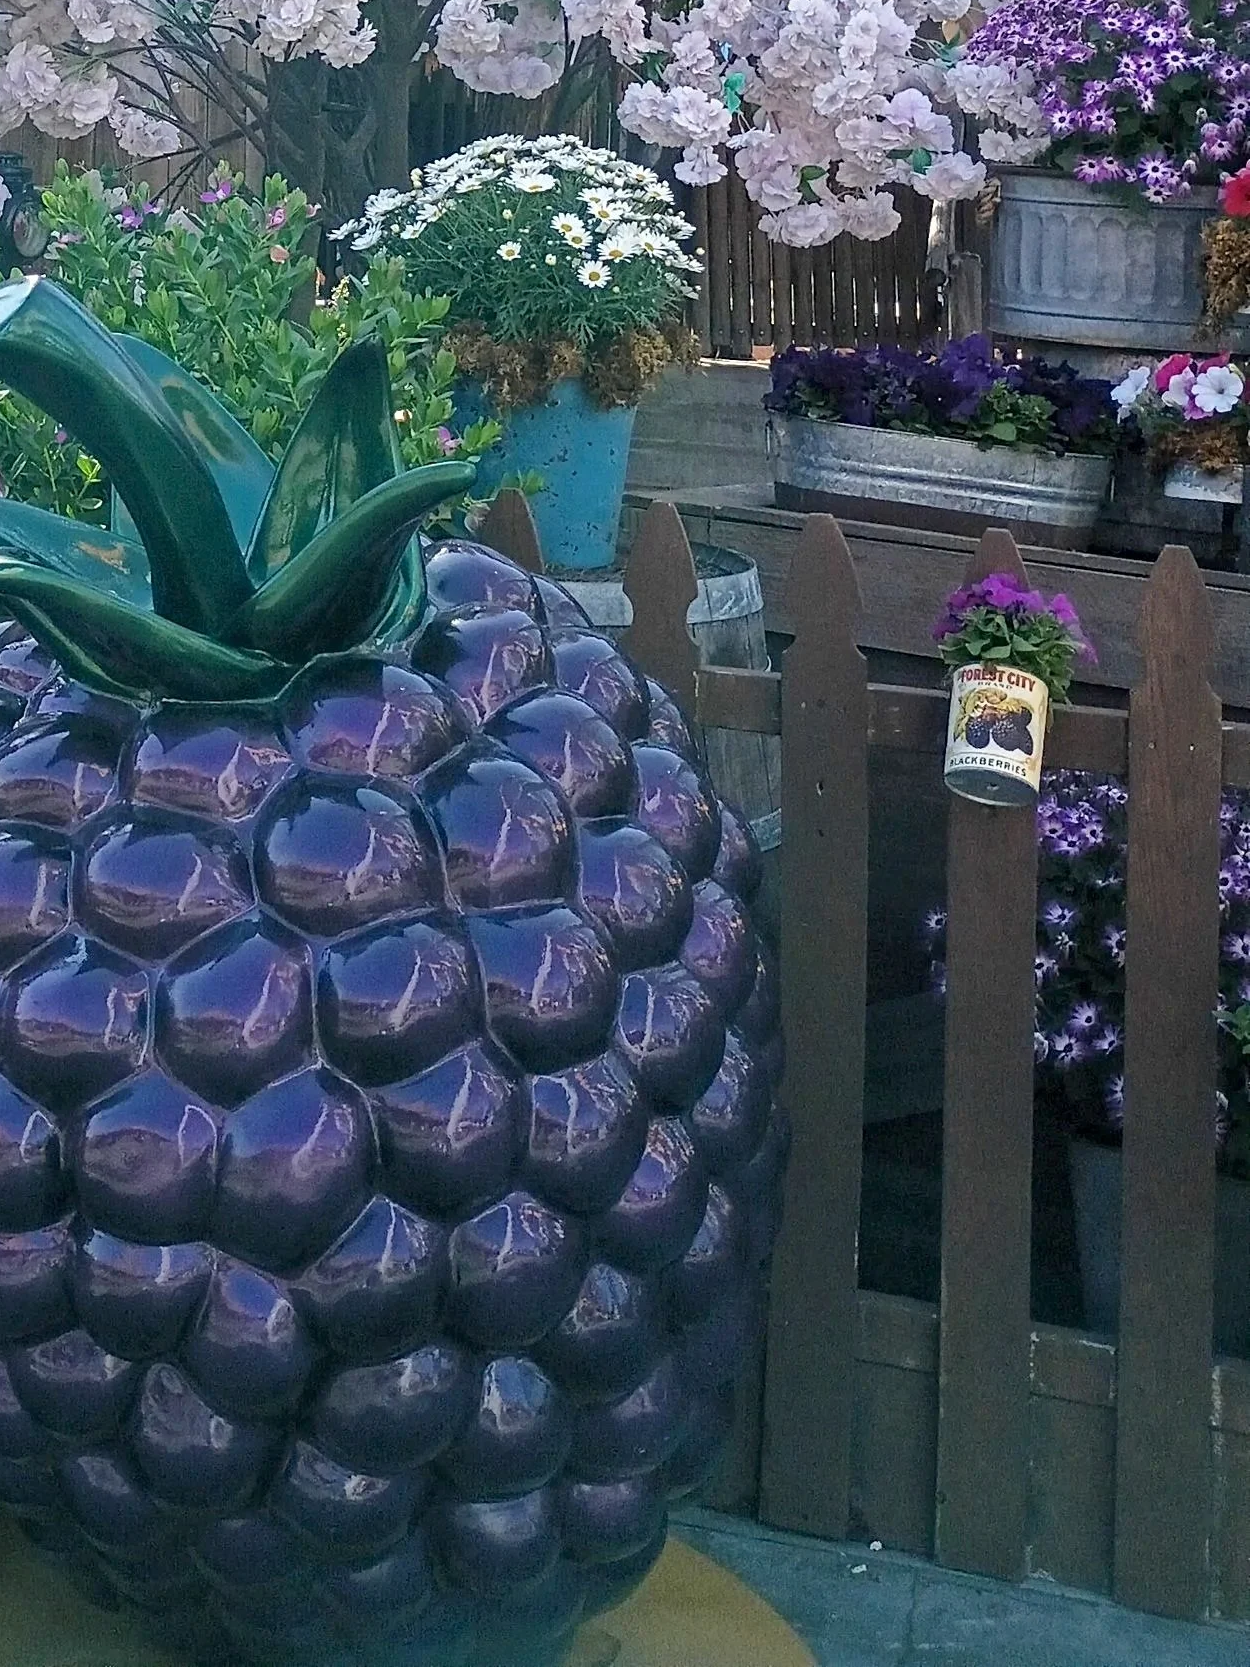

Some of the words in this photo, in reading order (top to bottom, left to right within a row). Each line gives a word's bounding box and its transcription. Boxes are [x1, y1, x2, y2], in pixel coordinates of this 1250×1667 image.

[961, 668, 1005, 683] FOREST
[1007, 671, 1036, 692] CITY
[977, 681, 1013, 689] BRAND
[949, 756, 1027, 777] BLACKBERRIES
